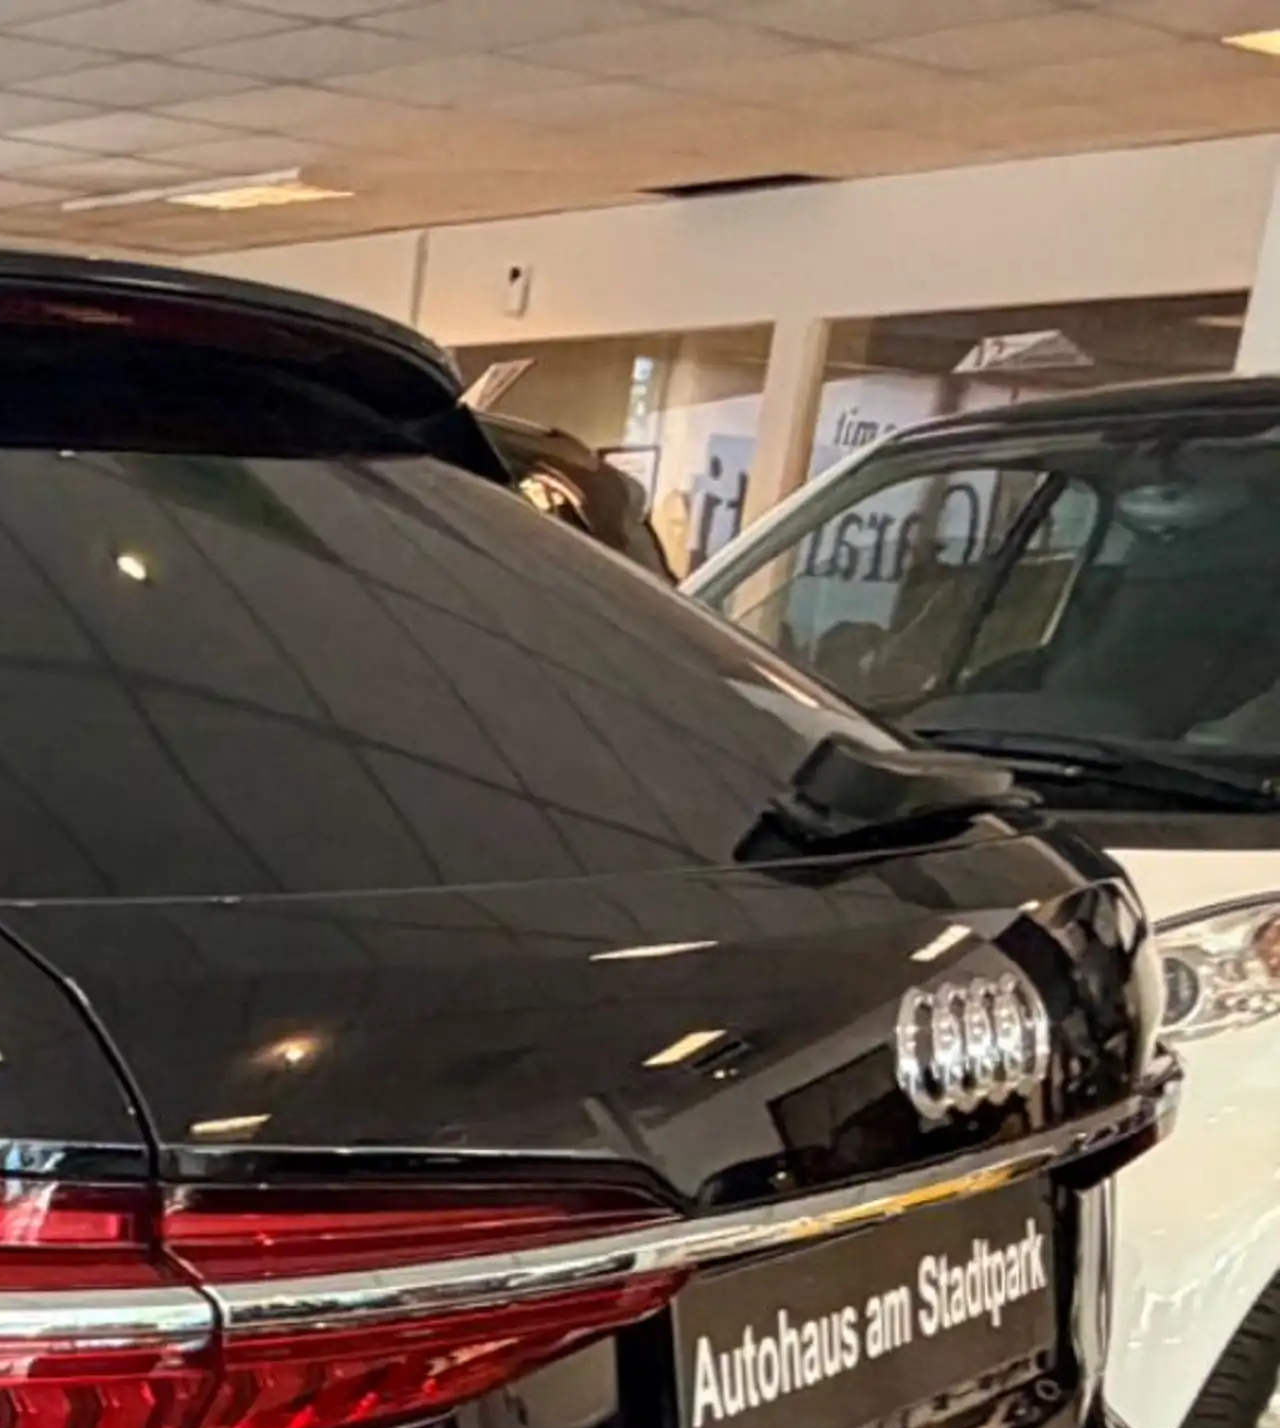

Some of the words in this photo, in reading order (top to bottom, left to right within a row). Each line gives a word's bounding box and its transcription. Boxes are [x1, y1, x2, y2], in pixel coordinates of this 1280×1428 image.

[691, 1303, 858, 1428] Autohaus
[865, 1284, 911, 1359] am
[917, 1218, 1047, 1337] Stadtpark
